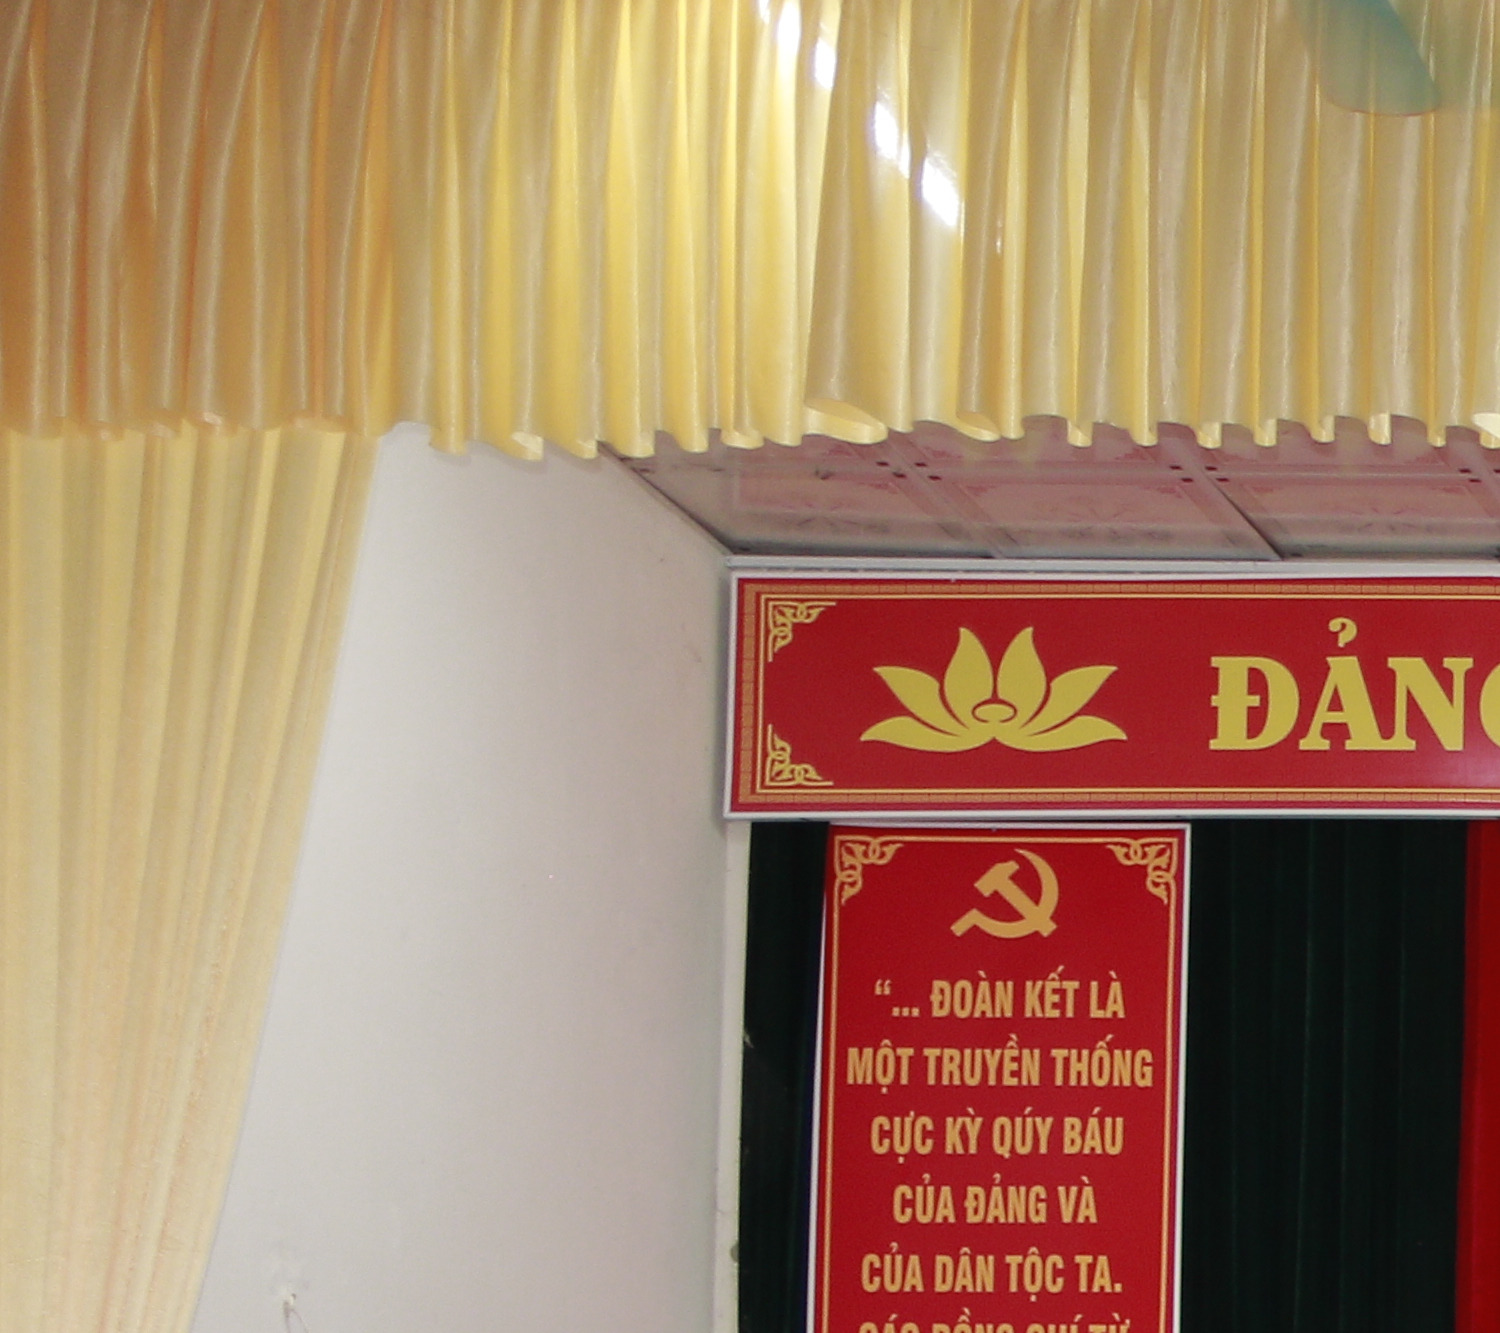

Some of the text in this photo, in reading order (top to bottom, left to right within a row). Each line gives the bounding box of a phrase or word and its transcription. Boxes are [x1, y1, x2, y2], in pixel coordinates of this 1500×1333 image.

[874, 964, 1126, 1019] “... ĐOÀN KẾT LÀ
[847, 1033, 1153, 1094] MỘT TRUYỀN THỐNG
[870, 1110, 934, 1164] CỰC
[945, 1107, 984, 1155] KỲ
[1063, 1106, 1124, 1156] BÁU
[893, 1172, 1098, 1224] CỦA ĐẢNG VÀ
[861, 1241, 1123, 1302] CỦA DÂN TỘC TA.
